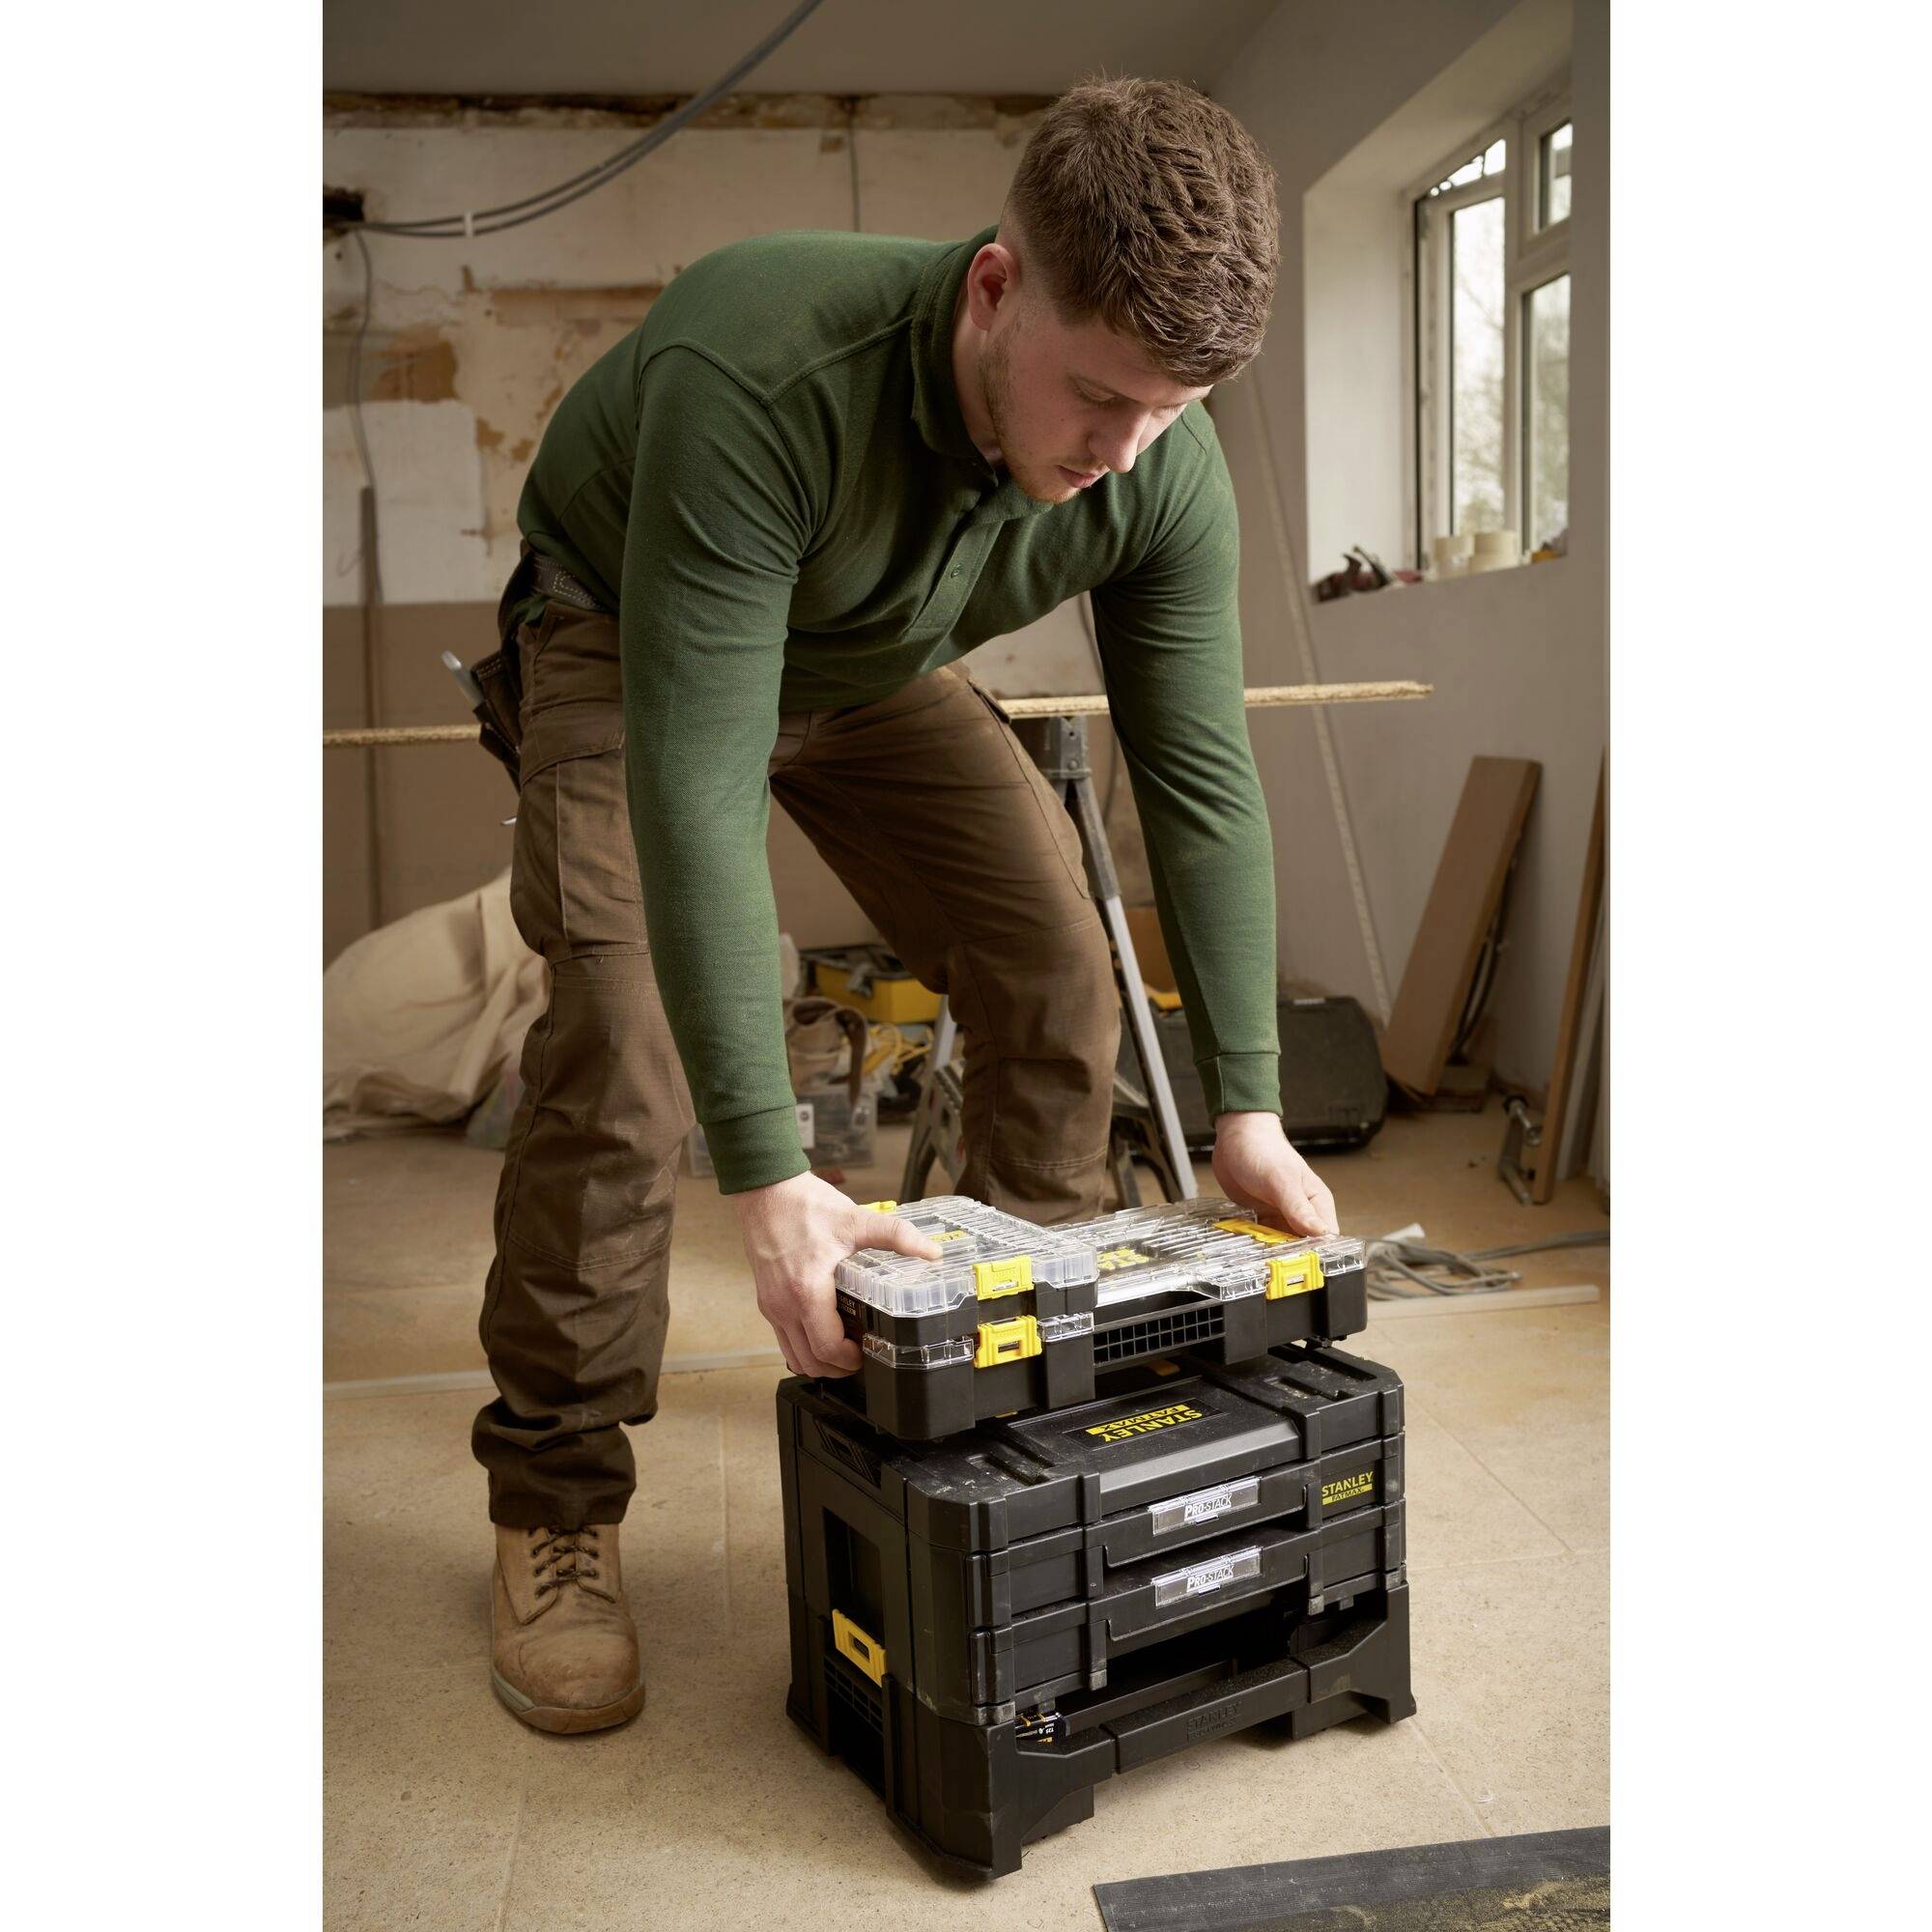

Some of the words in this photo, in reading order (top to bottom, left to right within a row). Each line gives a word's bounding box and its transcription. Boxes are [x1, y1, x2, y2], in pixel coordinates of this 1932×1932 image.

[1100, 1410, 1203, 1442] STANLEY
[1101, 1407, 1179, 1431] FATMAX
[1321, 1471, 1374, 1497] STANLEY
[1332, 1488, 1362, 1501] FATMAX
[1184, 1493, 1233, 1519] PRO-STACK
[1186, 1564, 1235, 1591] PRO-STACK
